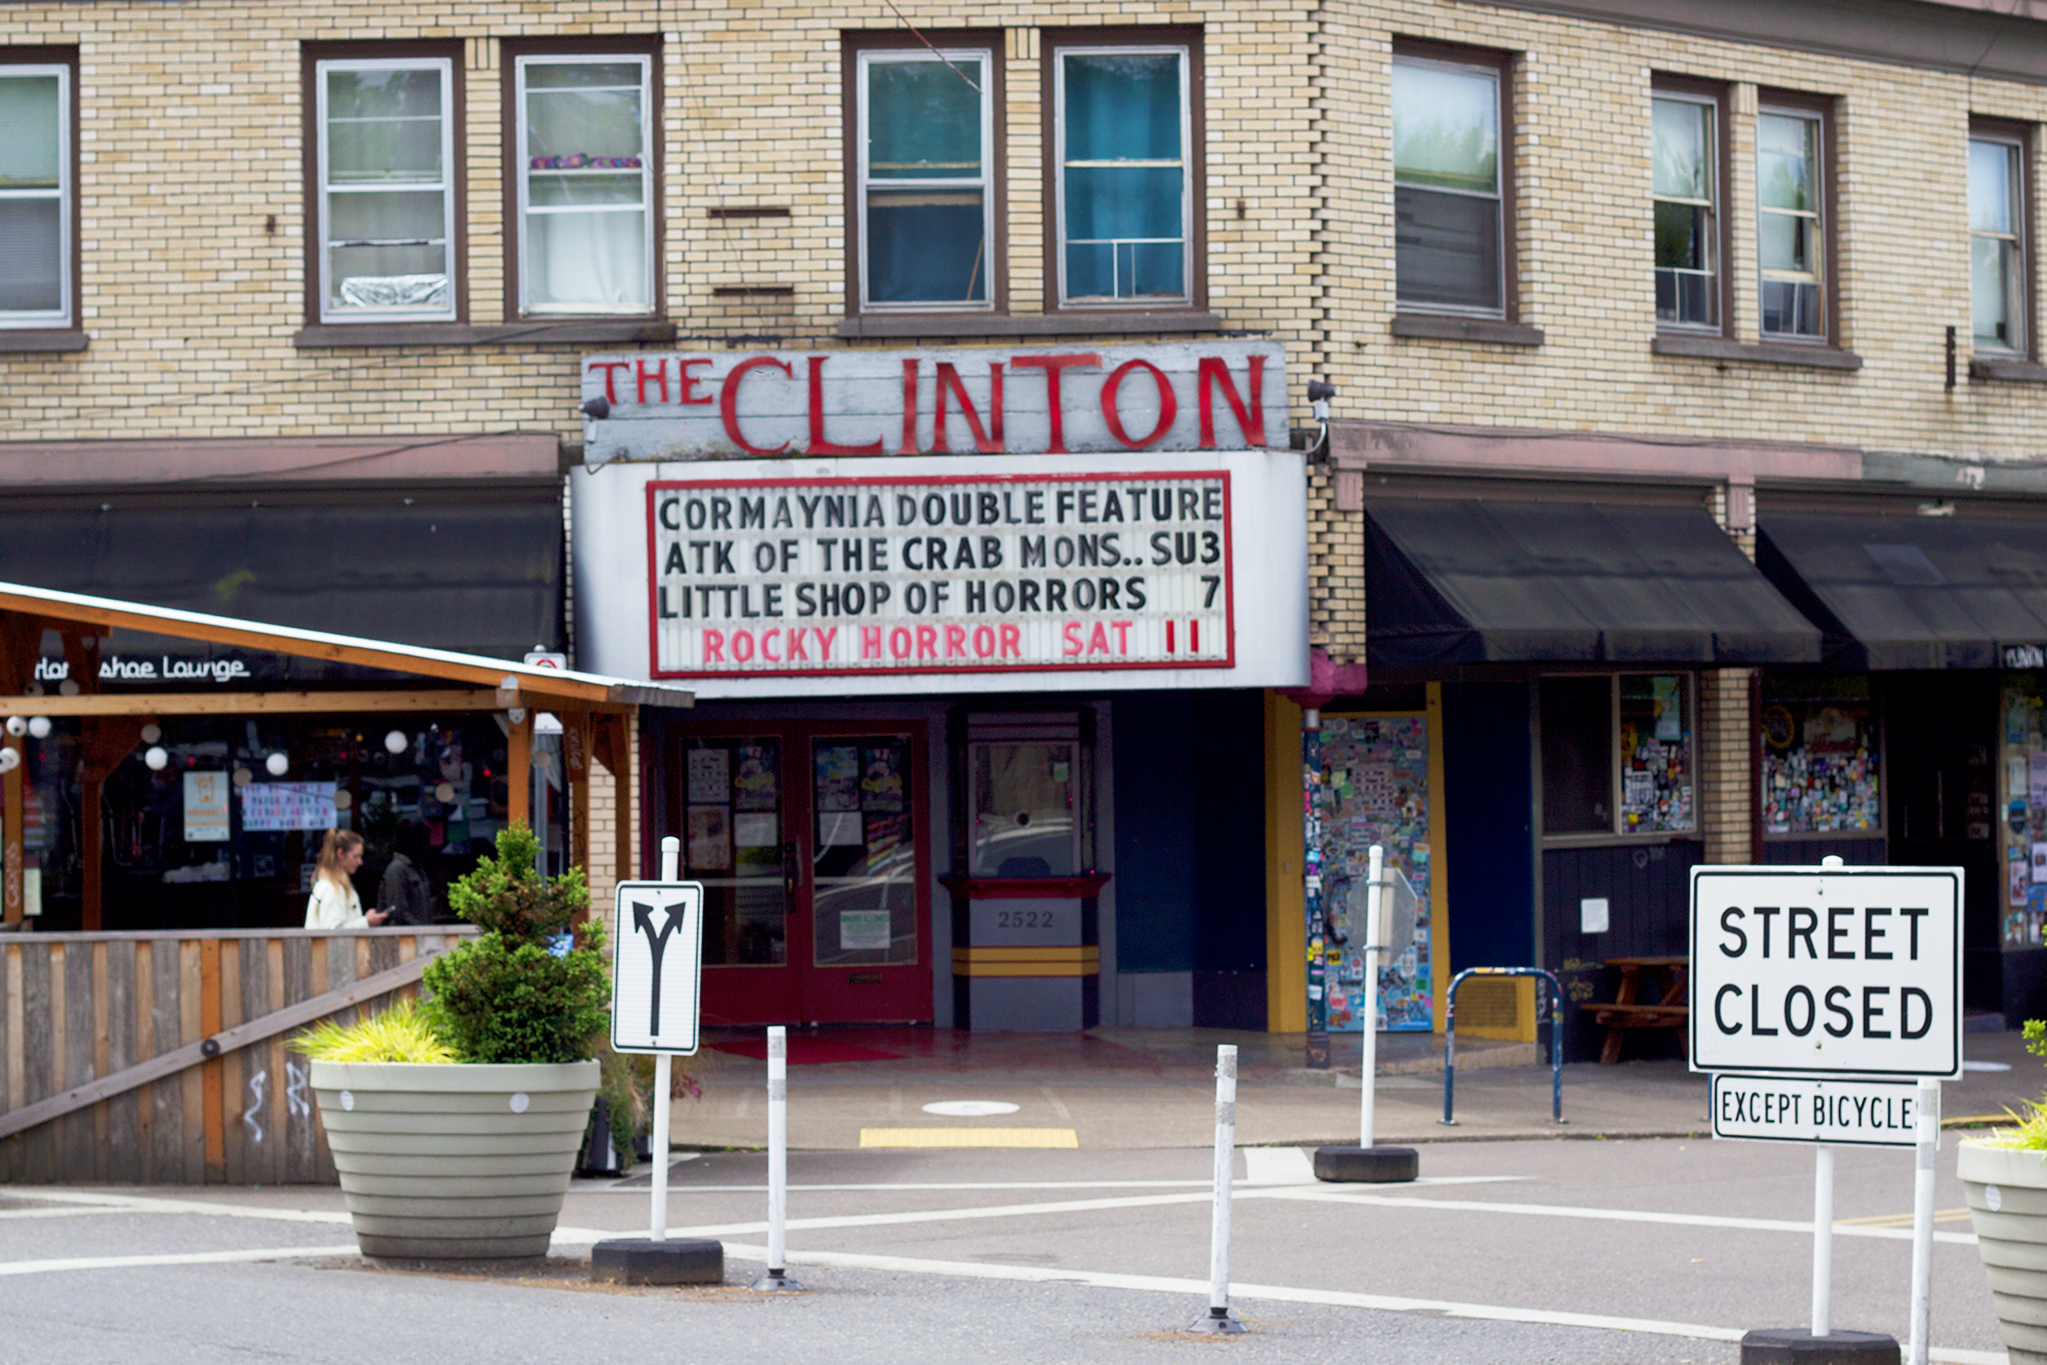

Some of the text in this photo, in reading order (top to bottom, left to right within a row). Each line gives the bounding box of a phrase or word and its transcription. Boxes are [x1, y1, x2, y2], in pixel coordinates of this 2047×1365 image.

[588, 353, 1267, 456] THE CLINTON
[659, 487, 1222, 530] CORMAYNIA DOUBLE FEATURE
[665, 540, 736, 574] ATK
[754, 539, 798, 573] OF
[817, 537, 888, 571] THE
[902, 535, 1003, 570] CRAB
[658, 575, 1221, 618] LITTLE SHOP OF HORRORS 7
[702, 627, 838, 662] ROCKY
[860, 623, 1022, 659] HORROR
[1062, 620, 1133, 655] SAT
[162, 655, 251, 682] Lounge
[998, 911, 1053, 928] 2522
[1718, 906, 1929, 960] STREET
[1714, 983, 1933, 1039] CLOSED
[1721, 1091, 1919, 1129] EXCEPT BICYCLE
